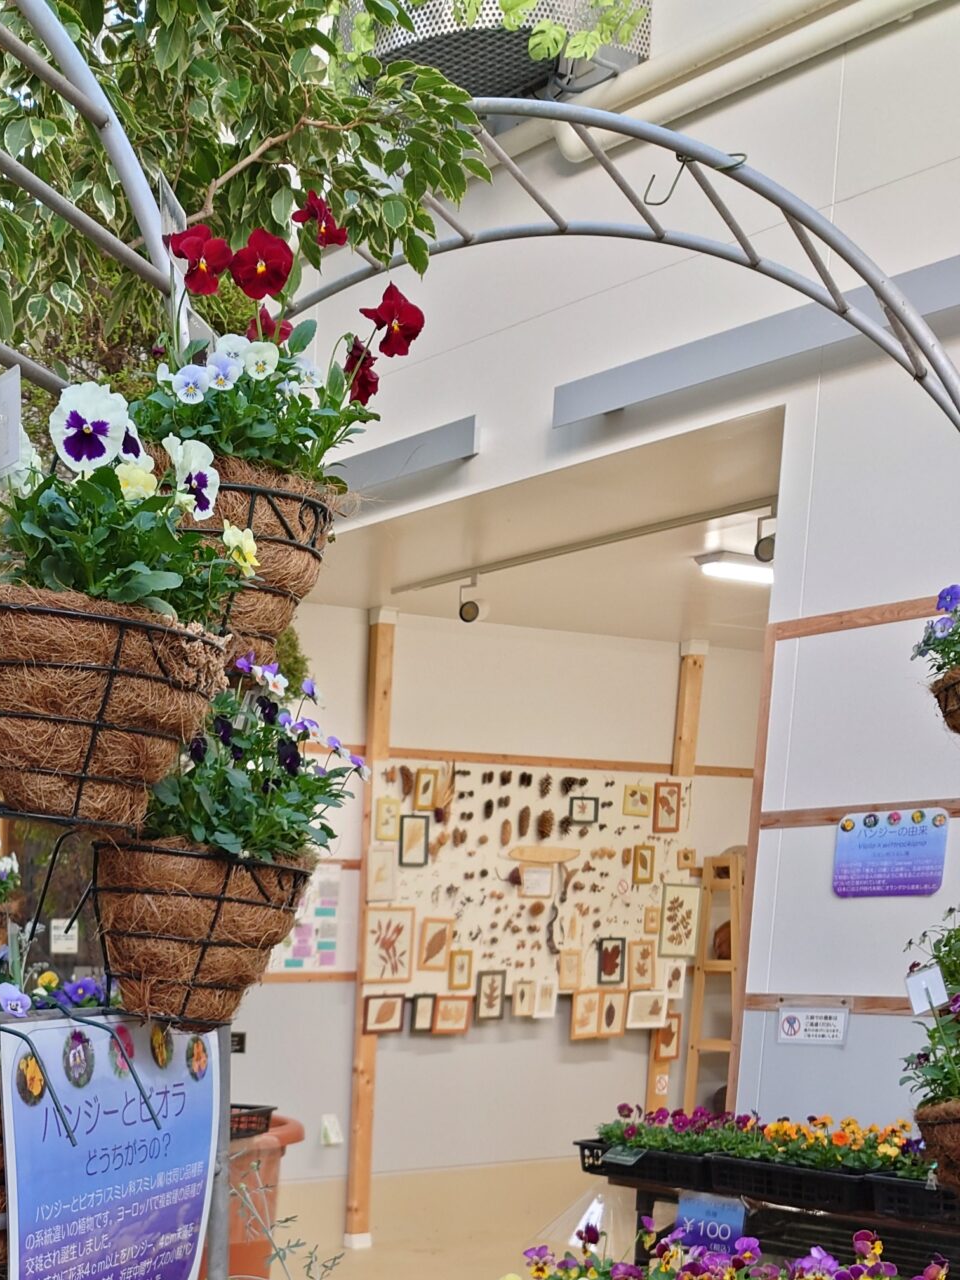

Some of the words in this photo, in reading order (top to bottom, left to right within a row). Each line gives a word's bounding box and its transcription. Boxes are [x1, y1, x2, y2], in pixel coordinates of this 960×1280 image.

[86, 1132, 171, 1176] どうちがうの？
[683, 1216, 731, 1241] ¥100
